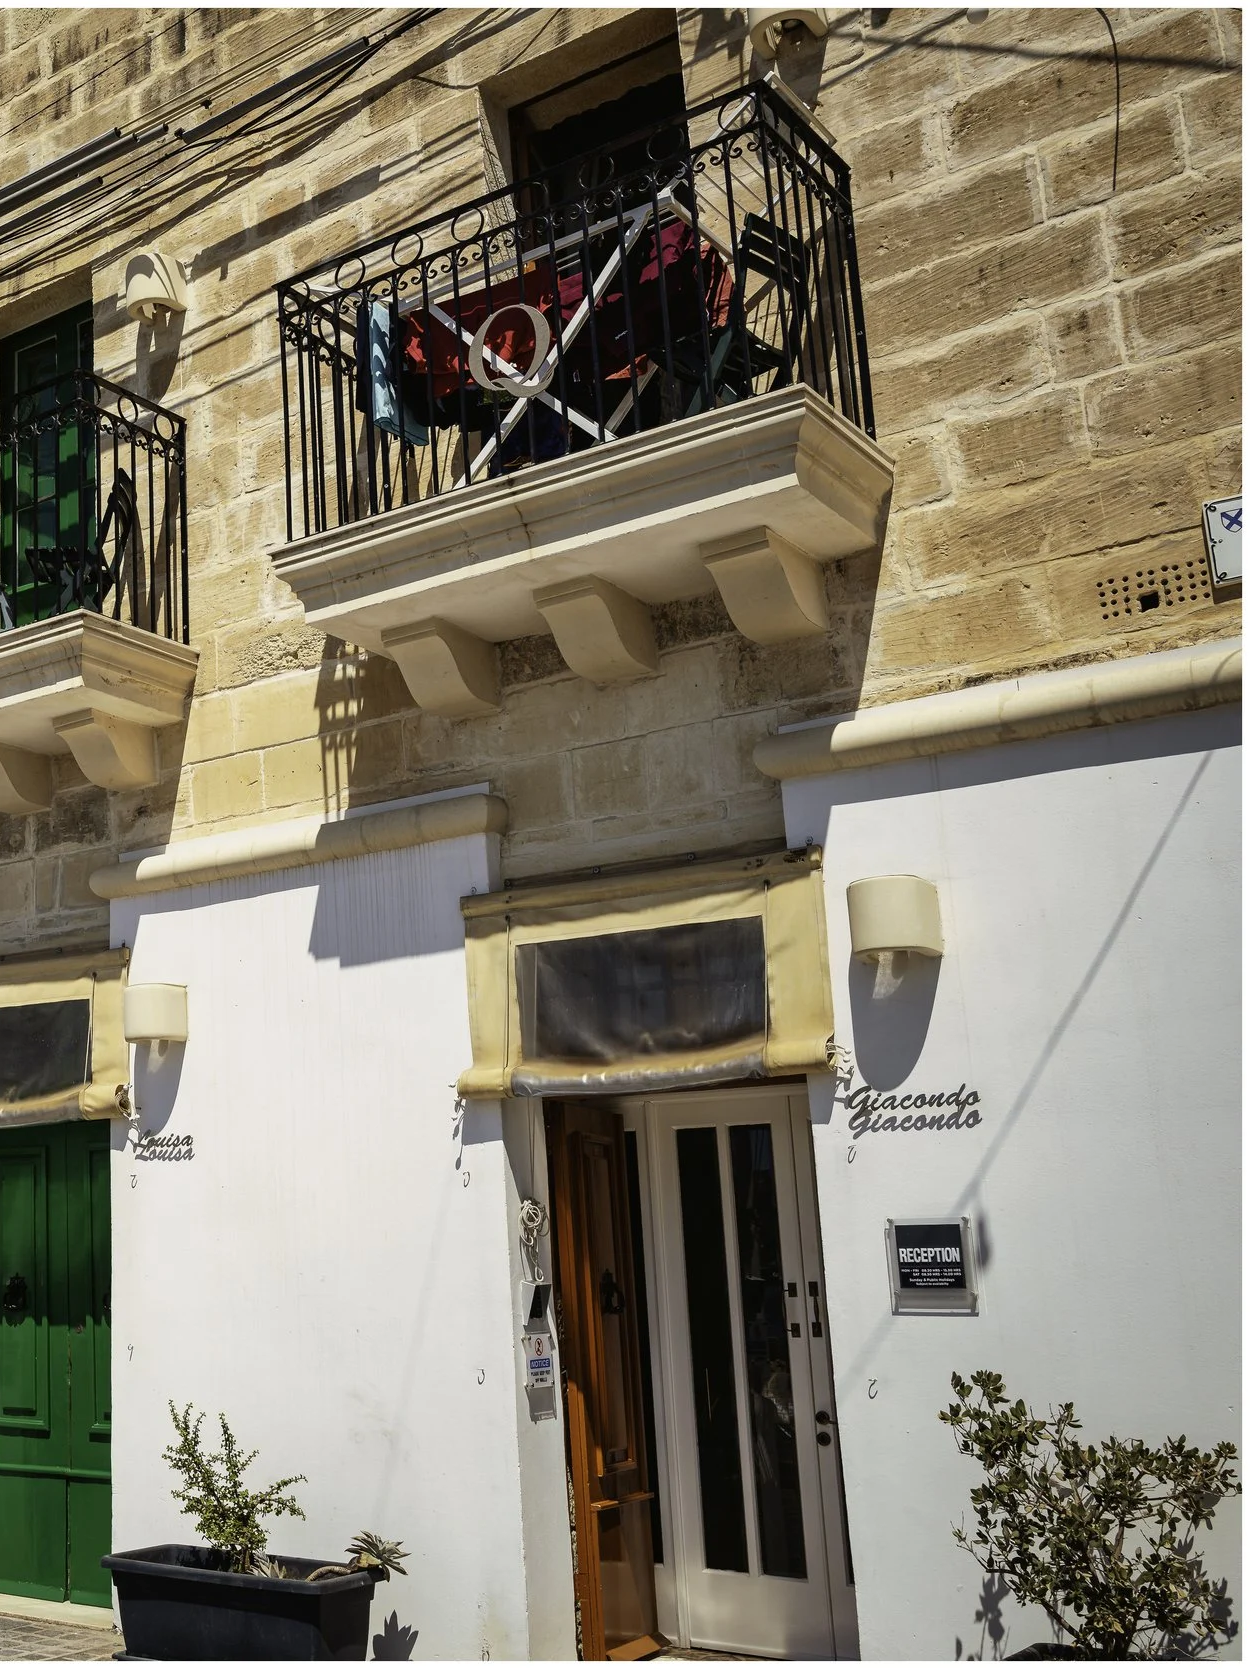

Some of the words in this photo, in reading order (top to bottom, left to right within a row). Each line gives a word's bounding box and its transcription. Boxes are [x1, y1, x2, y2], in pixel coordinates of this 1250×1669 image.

[849, 1083, 981, 1122] Giacondo
[899, 1247, 961, 1263] RECEPTION
[531, 1359, 549, 1368] NOTICE
